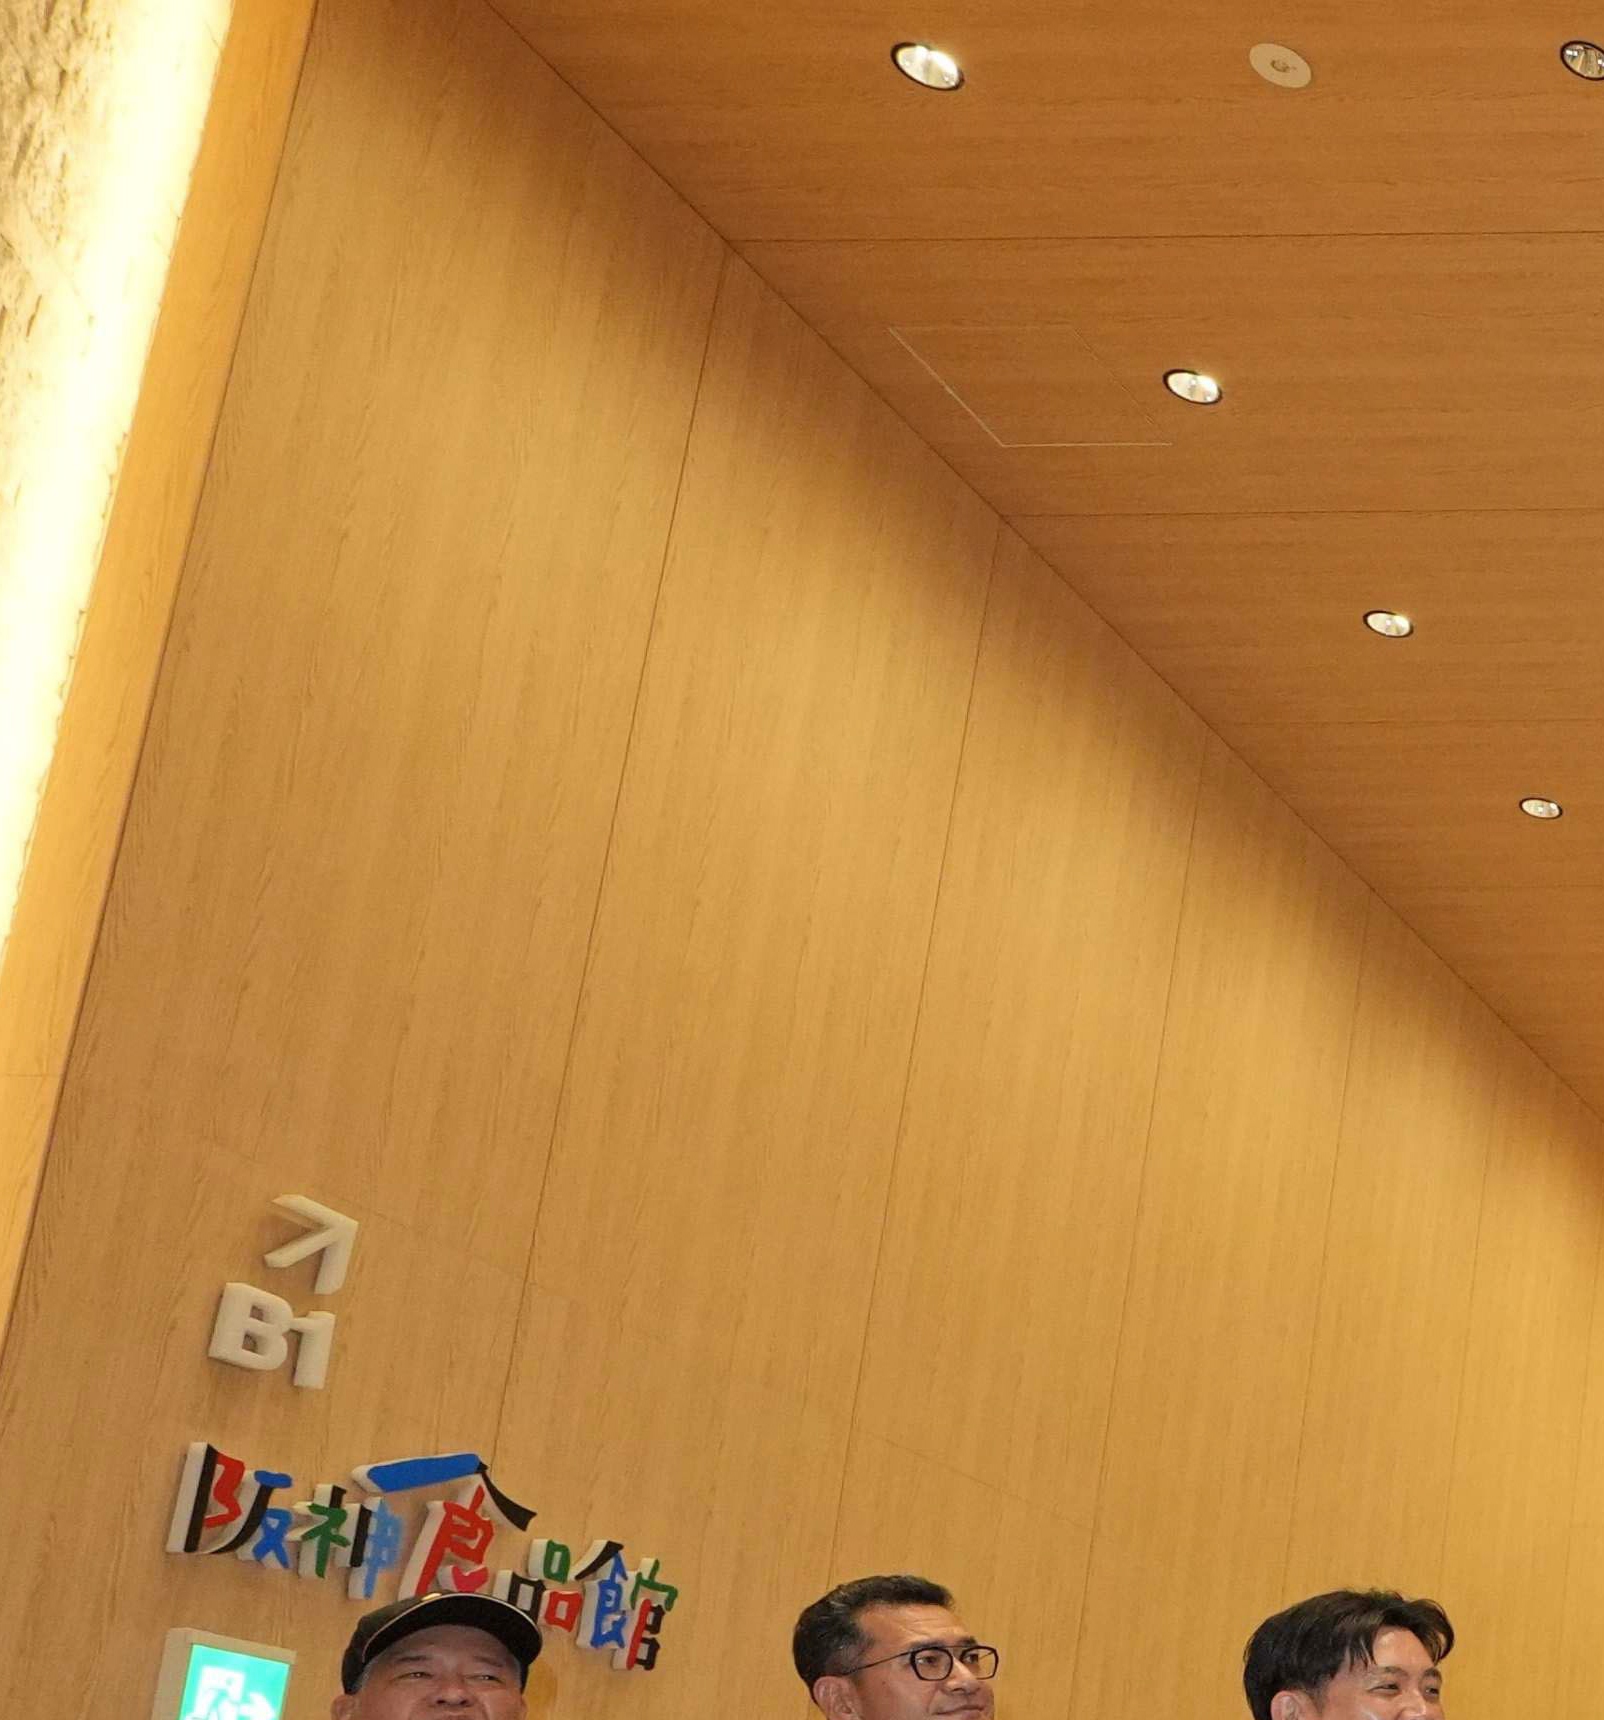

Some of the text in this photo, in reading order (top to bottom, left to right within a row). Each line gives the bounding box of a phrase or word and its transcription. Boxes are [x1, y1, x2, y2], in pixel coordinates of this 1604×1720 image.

[208, 1282, 336, 1389] B1
[166, 1442, 678, 1671] 阪神食品館
